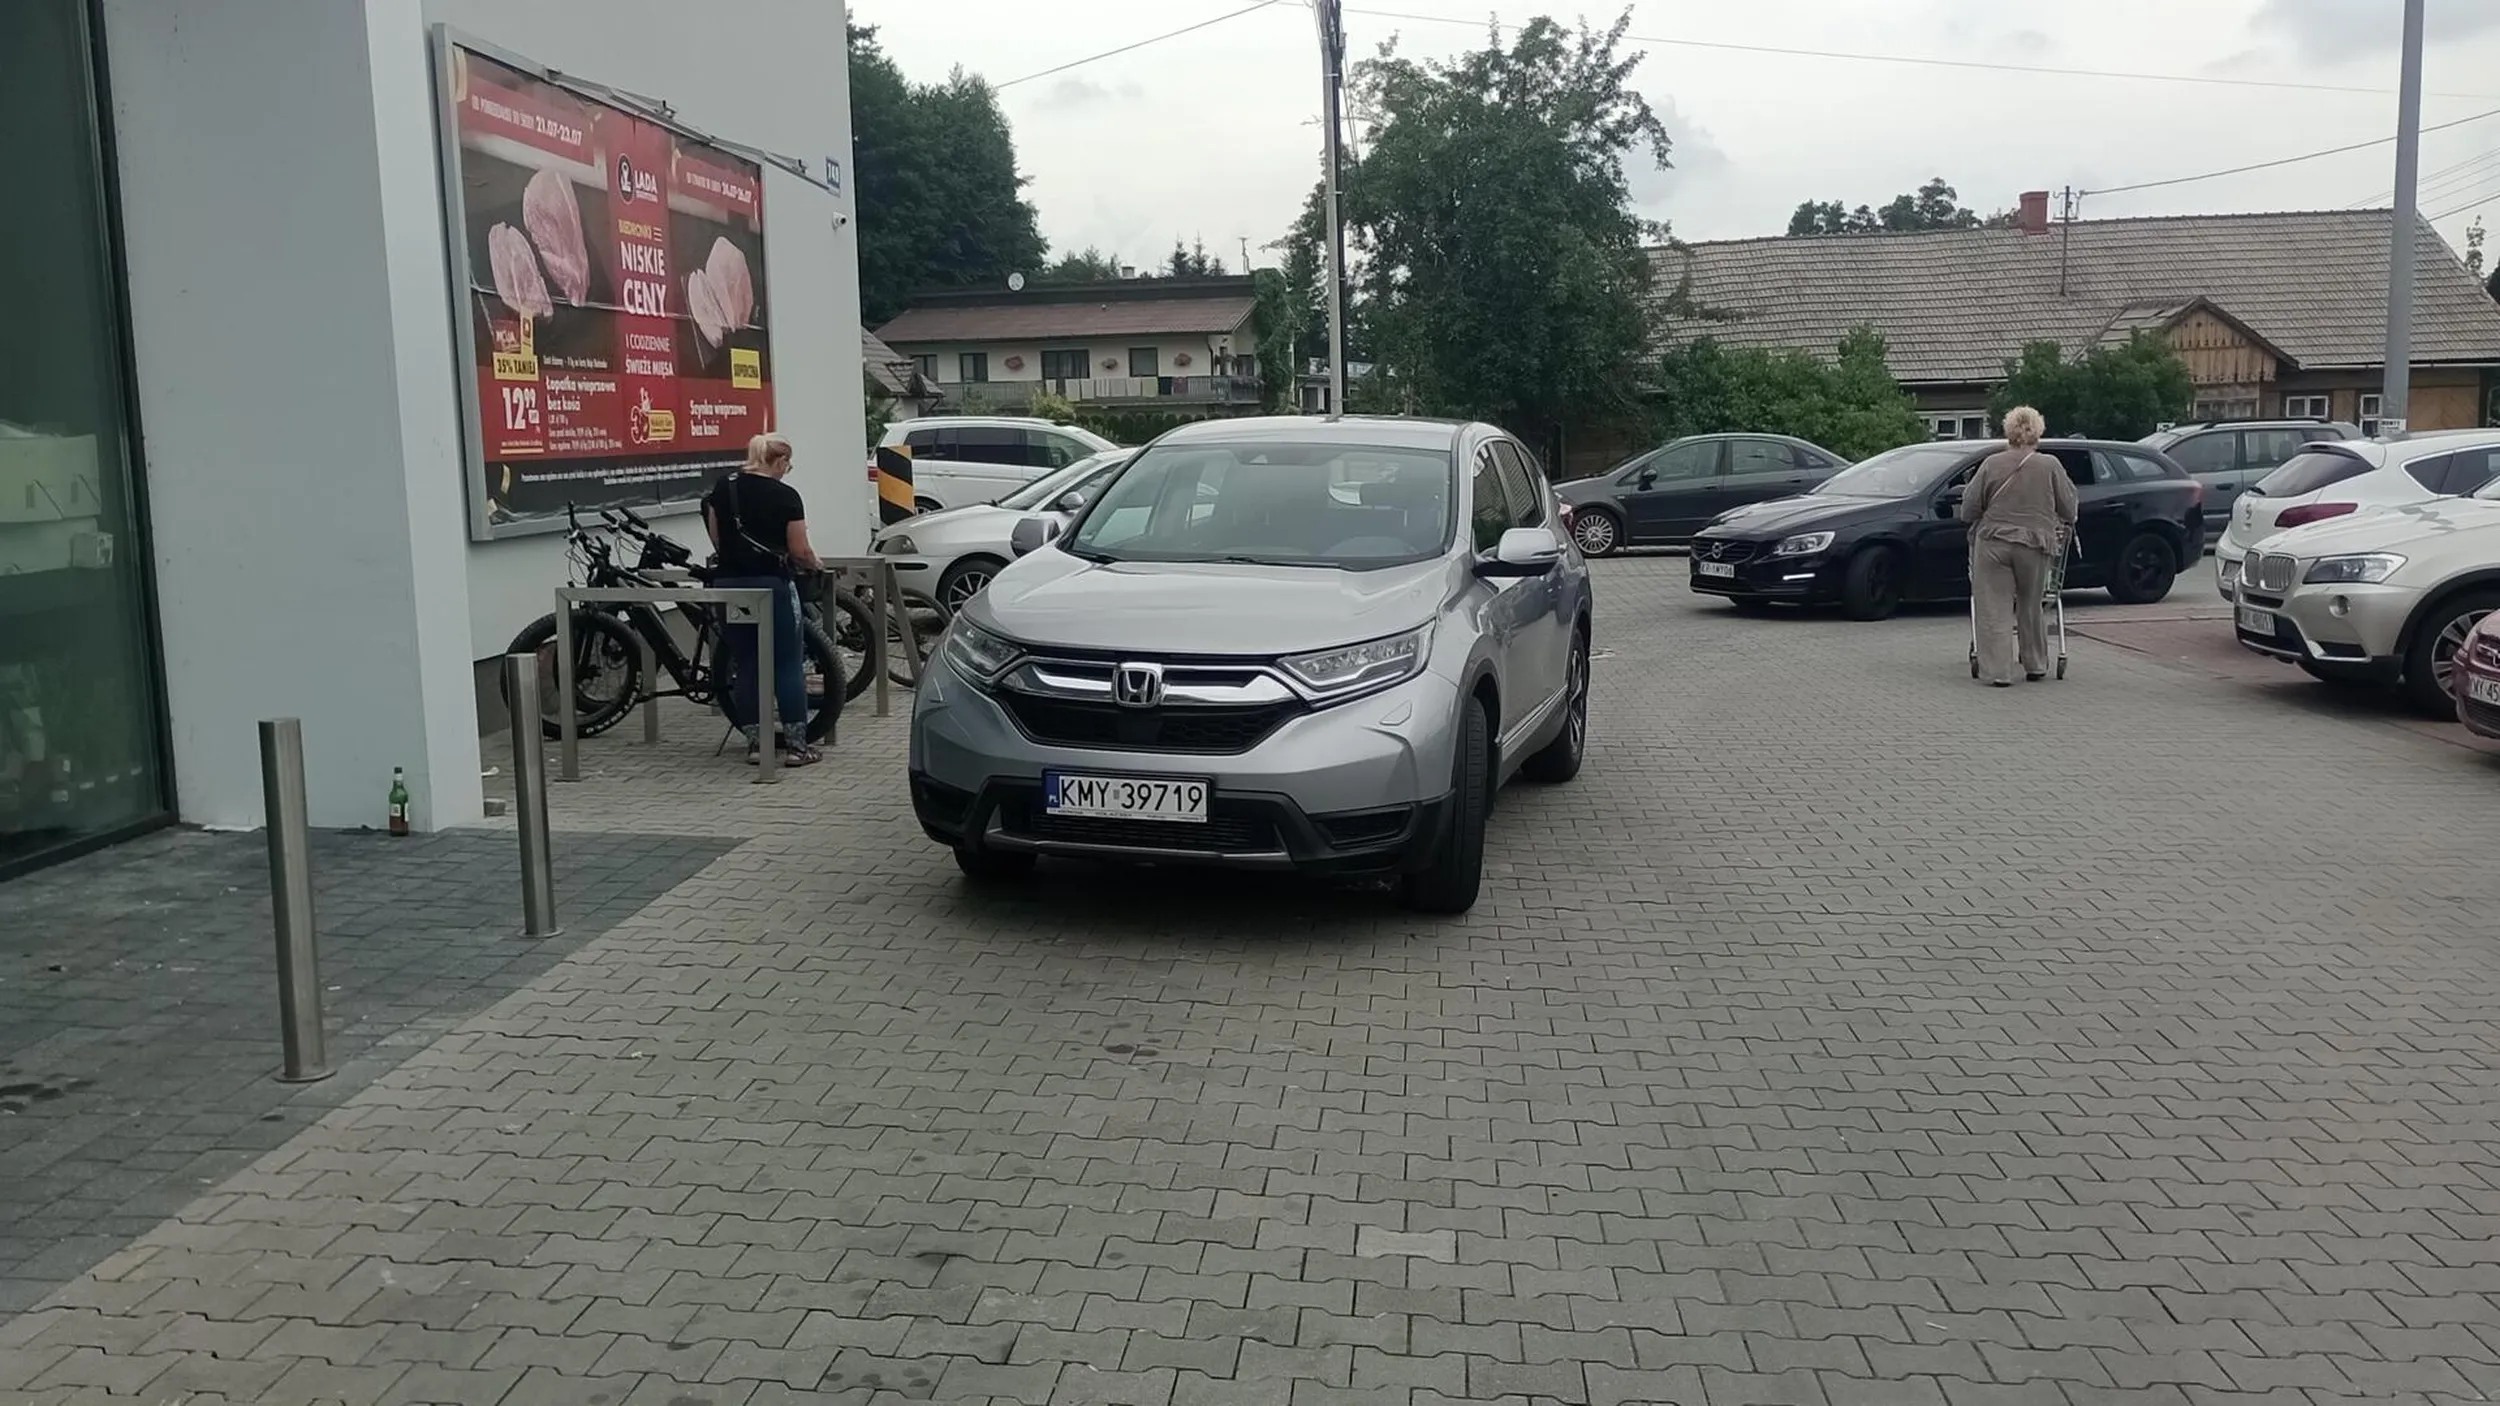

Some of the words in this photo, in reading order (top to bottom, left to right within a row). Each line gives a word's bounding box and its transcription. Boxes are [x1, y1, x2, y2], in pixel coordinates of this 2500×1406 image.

[536, 115, 582, 146] 21.07-23.07
[634, 170, 658, 194] LADA
[621, 241, 665, 276] NISKIE
[623, 278, 667, 317] CENY
[630, 333, 671, 352] CODZIENNIE
[625, 354, 652, 376] ŚWIEŻE
[652, 359, 675, 379] MIĘSA
[503, 386, 526, 430] 12
[547, 394, 562, 411] bez
[690, 400, 713, 419] Szynka
[1061, 779, 1110, 808] KMY
[1120, 783, 1203, 813] 39719
